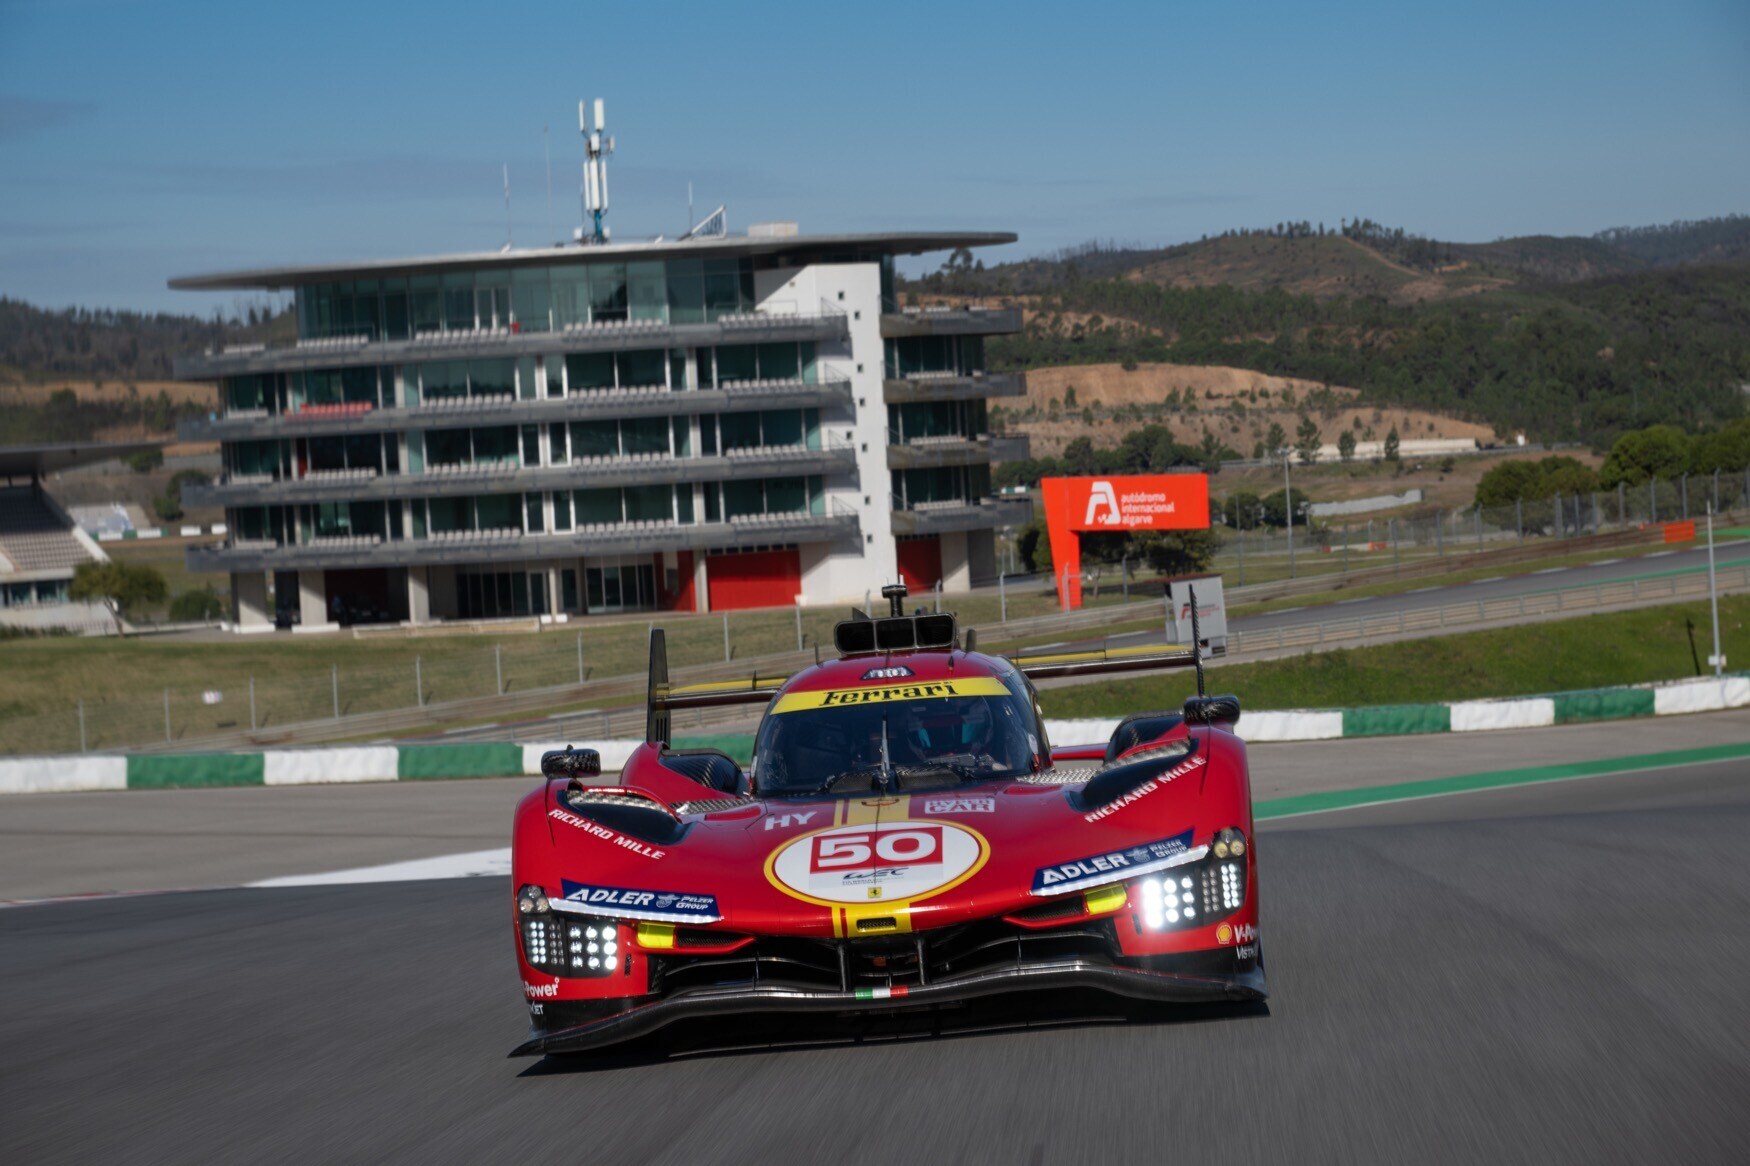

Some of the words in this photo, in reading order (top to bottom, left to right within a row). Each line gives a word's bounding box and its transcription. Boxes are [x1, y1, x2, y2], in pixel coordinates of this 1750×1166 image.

[1121, 501, 1175, 513] internacional
[1121, 513, 1153, 526] algarve
[819, 681, 958, 707] Ferrari
[1084, 781, 1158, 823] RICHARD
[1157, 756, 1207, 784] MILLE
[765, 811, 818, 831] HY
[548, 808, 614, 840] RICHARD
[613, 835, 666, 860] MILLE
[818, 832, 936, 867] 50
[1043, 852, 1130, 885] ADLER
[565, 888, 655, 906] ADLER
[675, 902, 709, 911] GROUP
[681, 895, 714, 904] PELZER
